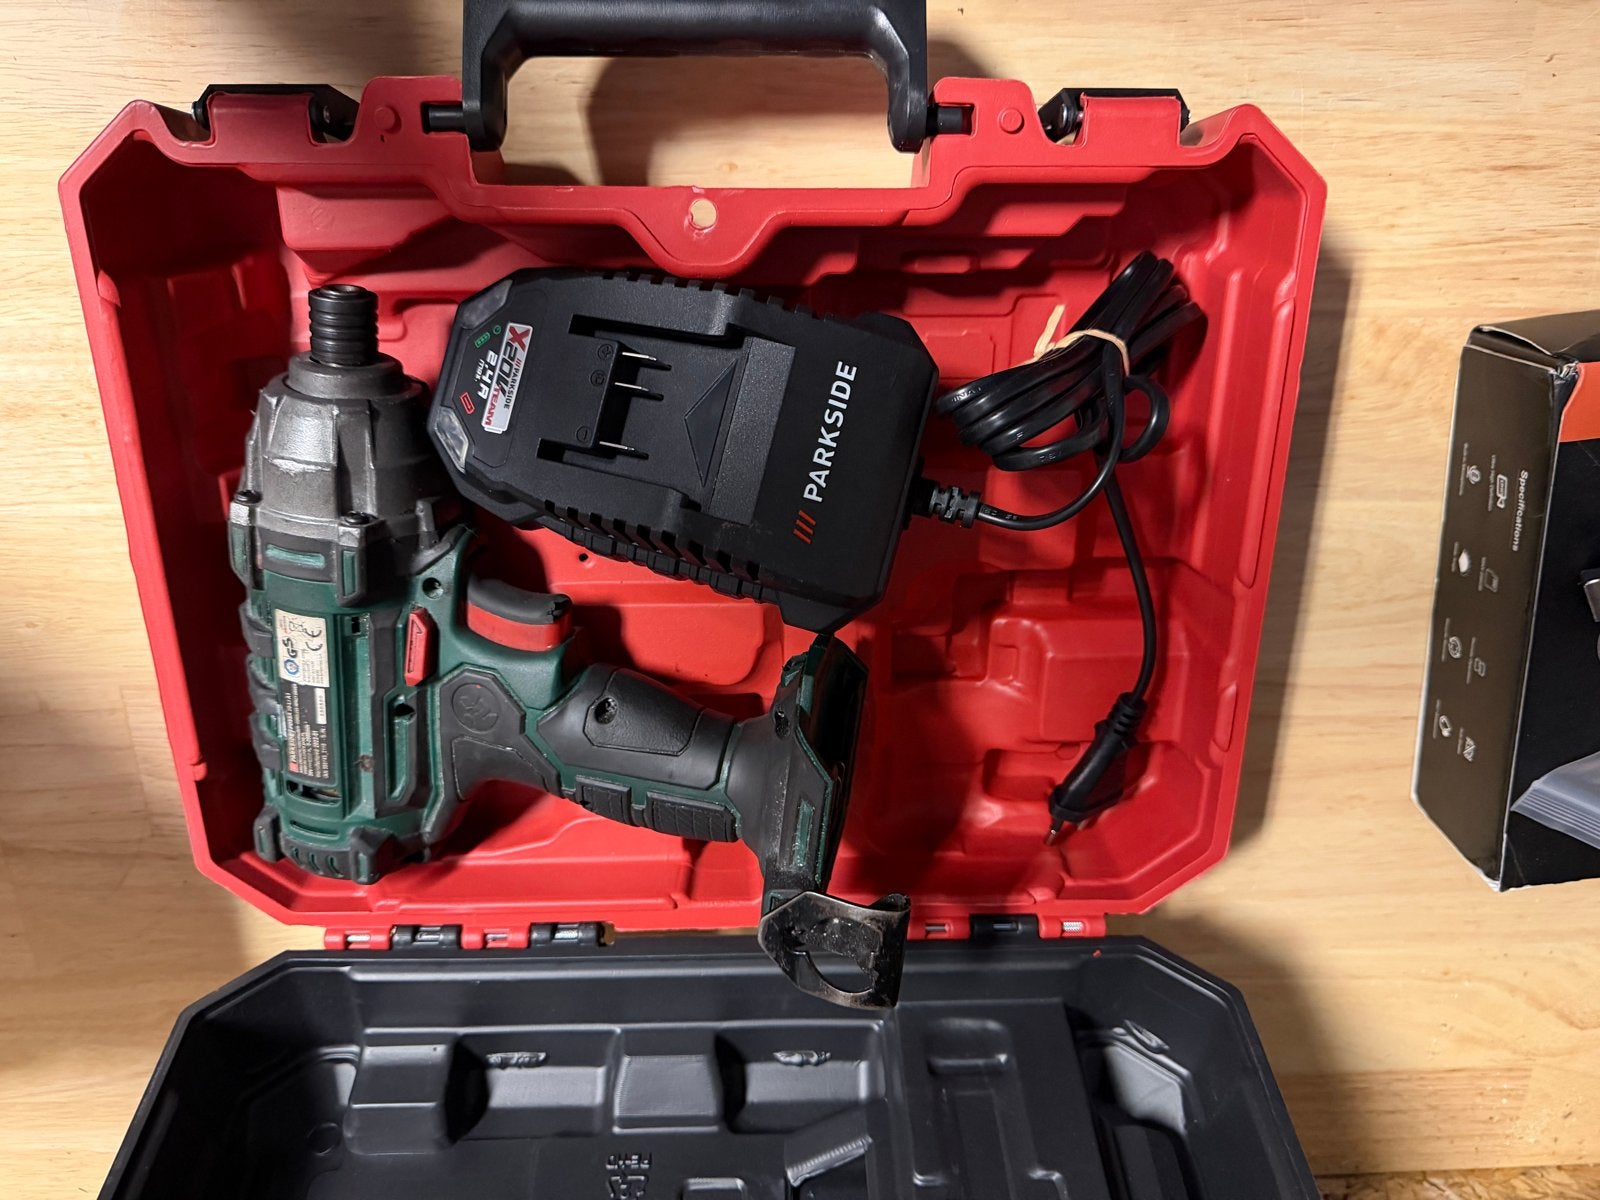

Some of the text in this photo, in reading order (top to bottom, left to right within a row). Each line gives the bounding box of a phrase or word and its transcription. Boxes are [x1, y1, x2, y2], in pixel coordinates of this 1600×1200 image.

[503, 367, 520, 410] PARKSIDE
[803, 361, 857, 502] PARKSIDE
[1511, 470, 1529, 551] Specifications
[282, 637, 297, 658] GS
